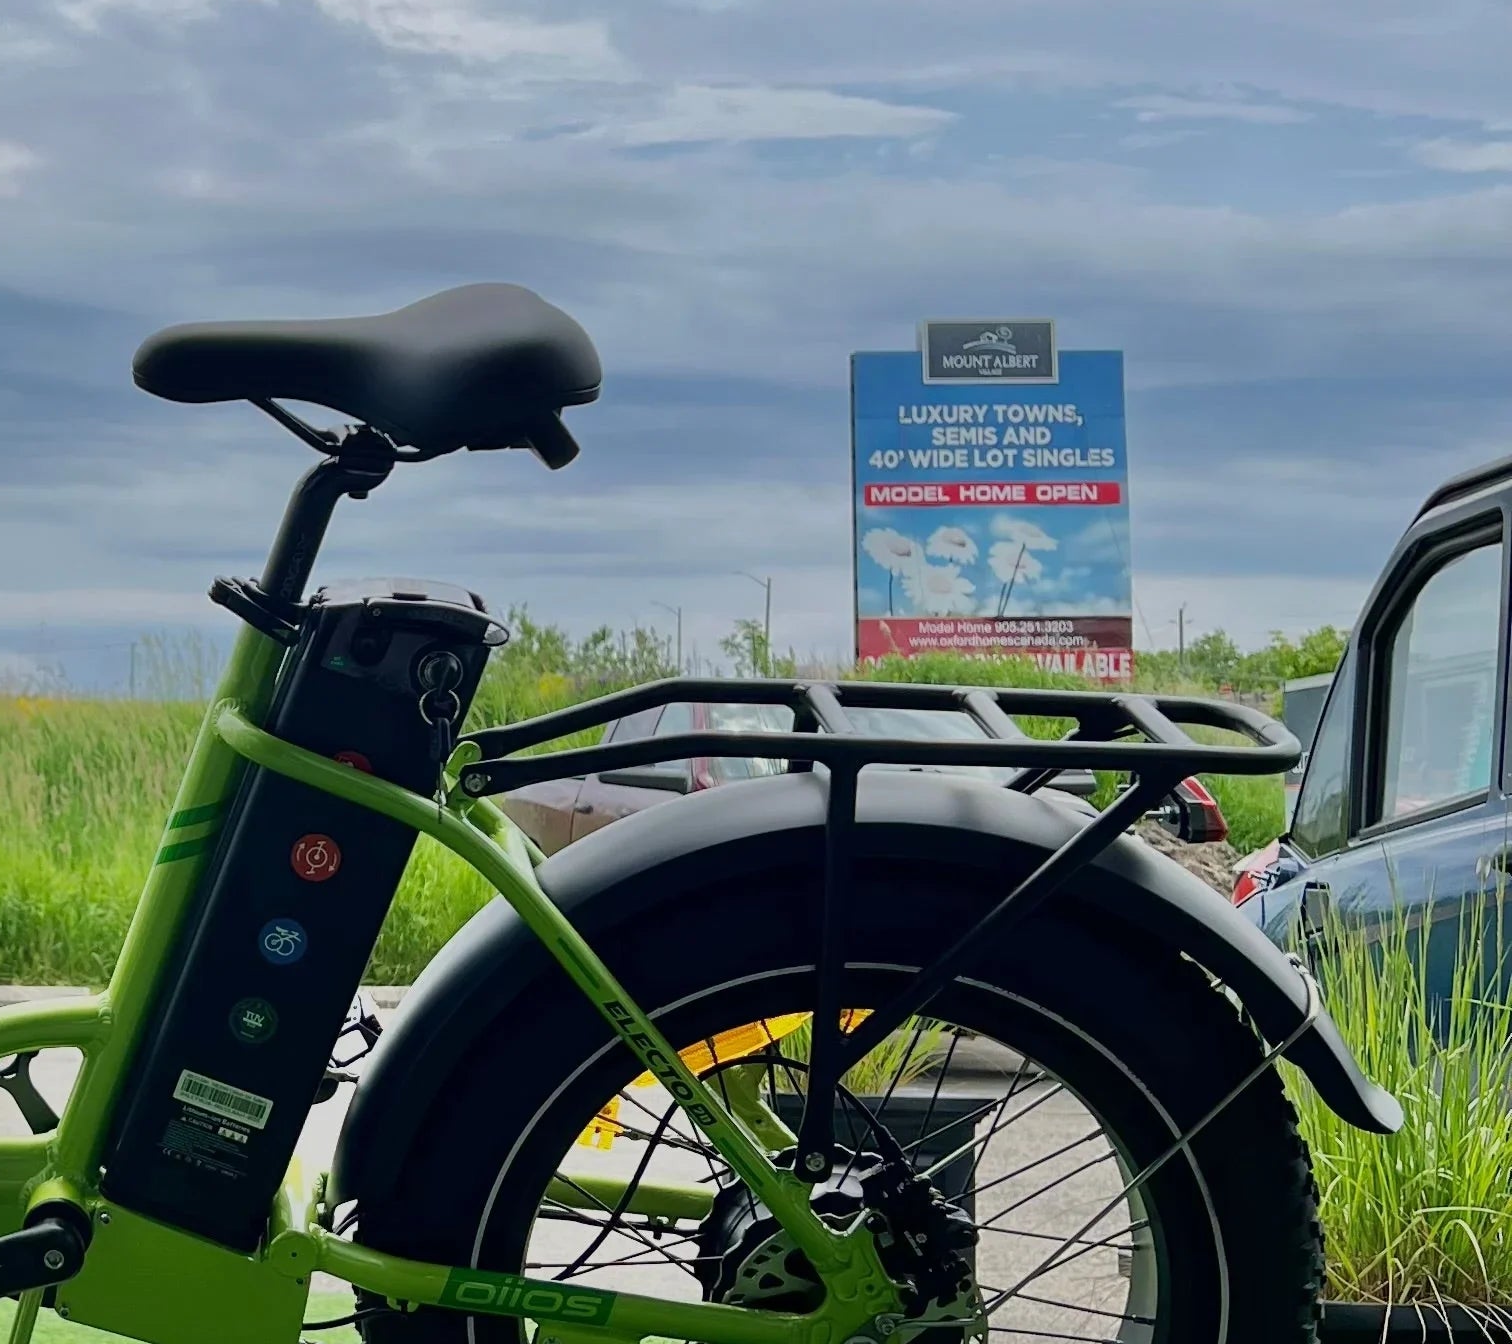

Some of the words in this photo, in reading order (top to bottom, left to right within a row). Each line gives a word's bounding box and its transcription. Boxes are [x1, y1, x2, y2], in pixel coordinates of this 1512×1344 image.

[943, 355, 992, 368] MOUNT
[993, 355, 1039, 368] ALBERT
[899, 405, 987, 424] LUXURY
[993, 405, 1083, 426] TOWNS,
[932, 427, 998, 446] SEMIS
[1003, 427, 1051, 445] AND
[868, 450, 904, 468] 40'
[908, 449, 968, 468] WIDE
[974, 449, 1018, 468] LOT
[1022, 448, 1115, 467] SINGLES
[870, 486, 949, 502] MODEL
[959, 485, 1026, 501] HOME
[1036, 484, 1098, 501] OPEN
[919, 622, 954, 634] Model
[957, 622, 992, 634] Home
[603, 1001, 693, 1101] ELECTO
[456, 1278, 602, 1317] oiios
